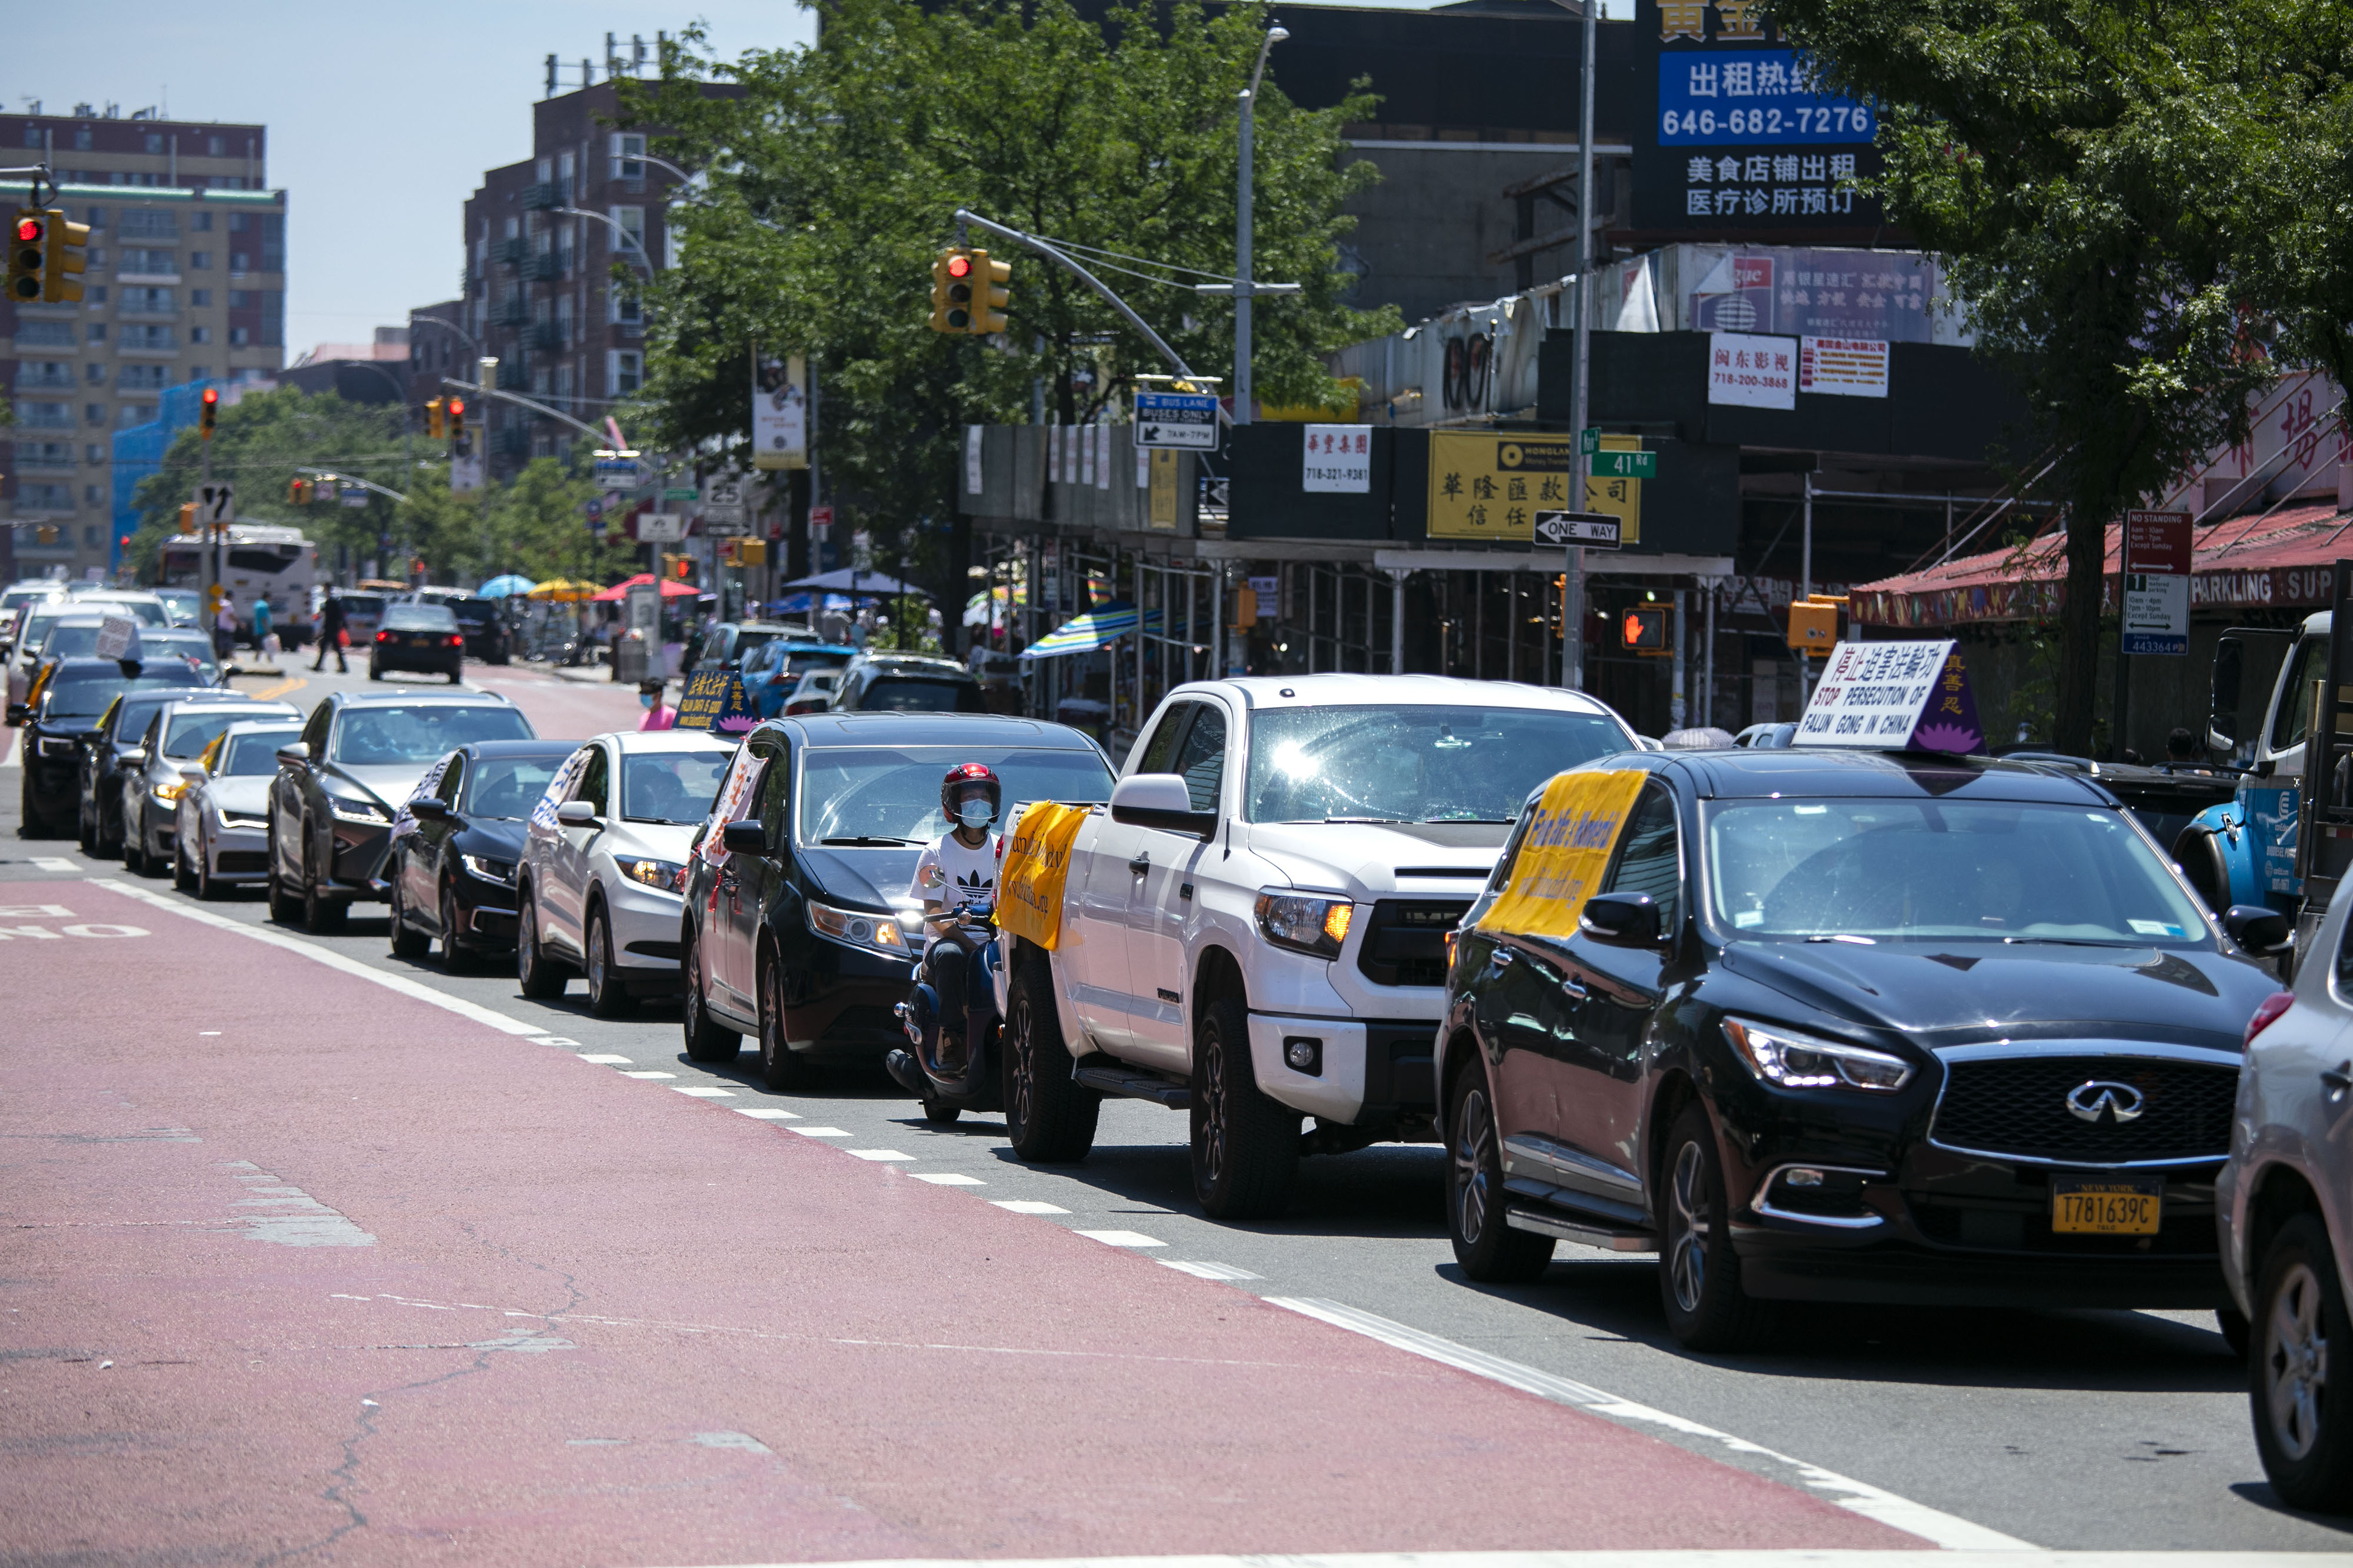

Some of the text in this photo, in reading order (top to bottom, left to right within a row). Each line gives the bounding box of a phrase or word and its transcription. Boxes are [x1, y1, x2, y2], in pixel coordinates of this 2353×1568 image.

[1662, 107, 1868, 135] 646-682-7276
[1687, 154, 1856, 183] 美食店铺出租
[1714, 372, 1788, 389] 718-200-3868
[1161, 398, 1209, 408] BUS LANE
[1142, 408, 1212, 419] BUSES ONLY
[1614, 454, 1648, 473] 41 Rd
[1548, 522, 1614, 539] ONE WAY
[2130, 542, 2172, 551] Except Sunday
[2134, 574, 2139, 590] 1
[2191, 573, 2272, 603] PARKLING
[2149, 597, 2161, 605] 4pm
[2149, 613, 2171, 622] Sunday
[2132, 641, 2171, 652] 443364
[1831, 644, 1941, 683] 停止迫害法輪功
[1940, 654, 1966, 715] 真善忍
[1814, 685, 1928, 706] STOP PERSECUTION OF
[1801, 713, 1912, 735] FALUN GONG IN CHINA
[2063, 1195, 2149, 1224] T781639C
